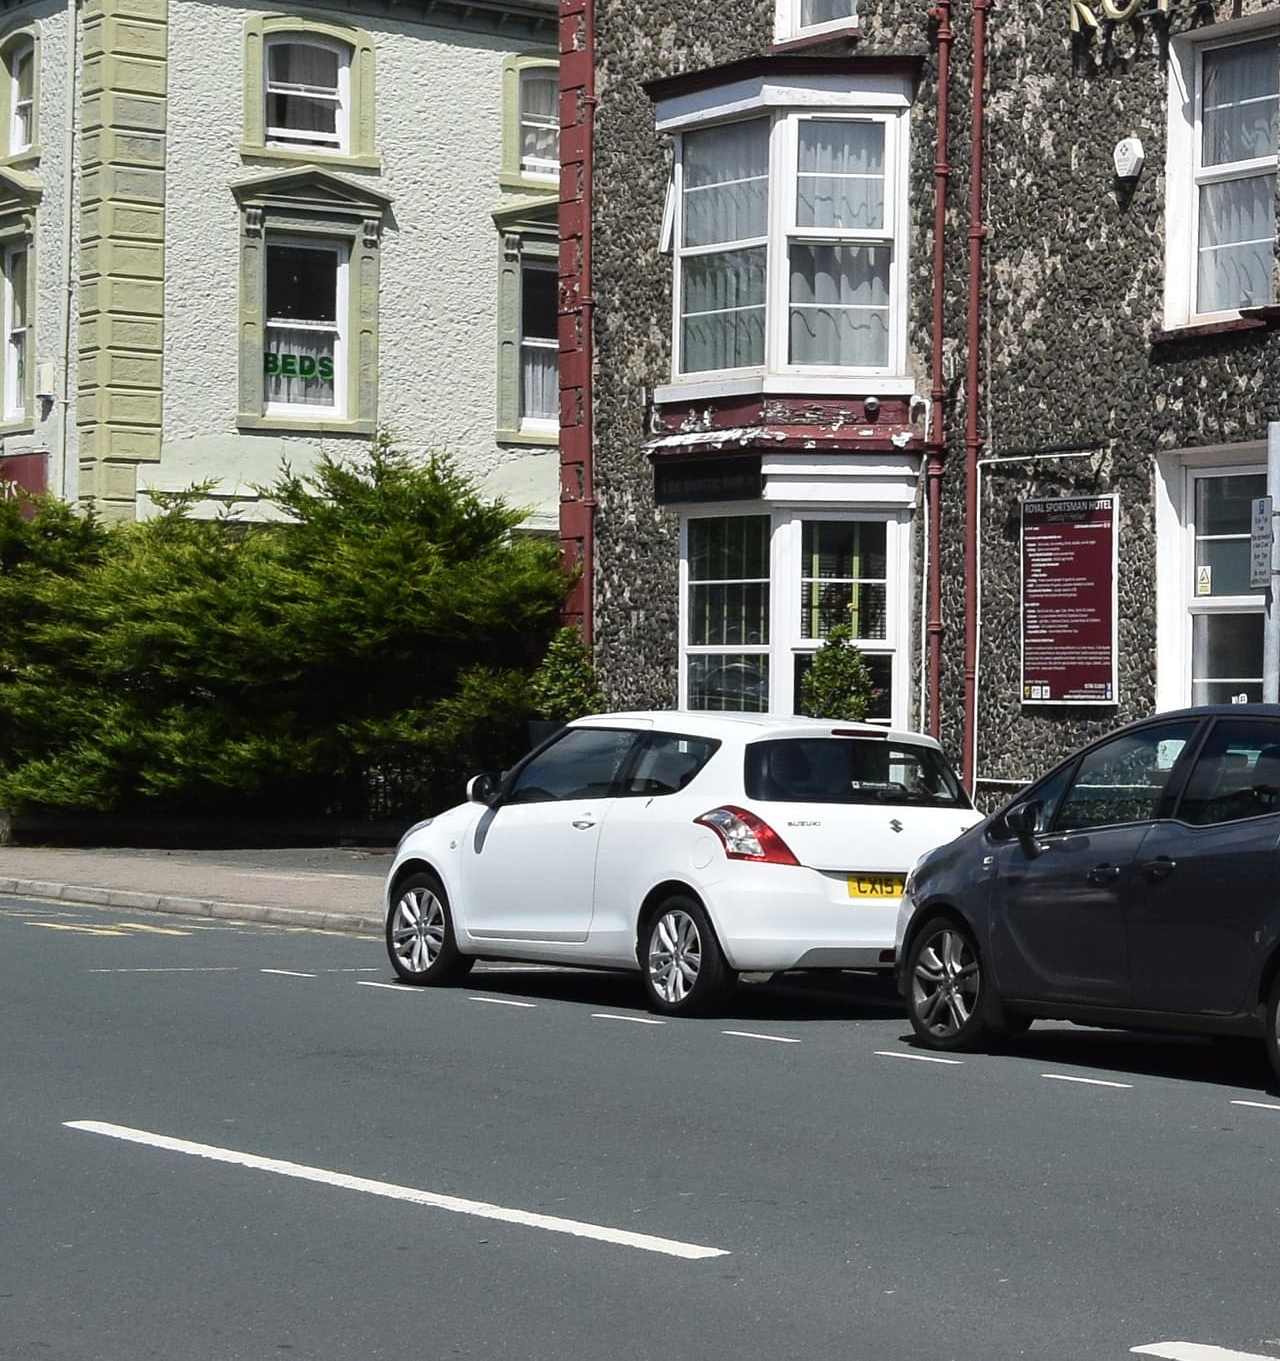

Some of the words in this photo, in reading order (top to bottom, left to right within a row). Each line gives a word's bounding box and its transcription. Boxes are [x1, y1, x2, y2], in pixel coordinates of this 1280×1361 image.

[263, 351, 334, 380] BEDS
[1088, 499, 1112, 511] HOTEL
[856, 876, 895, 895] CX15
